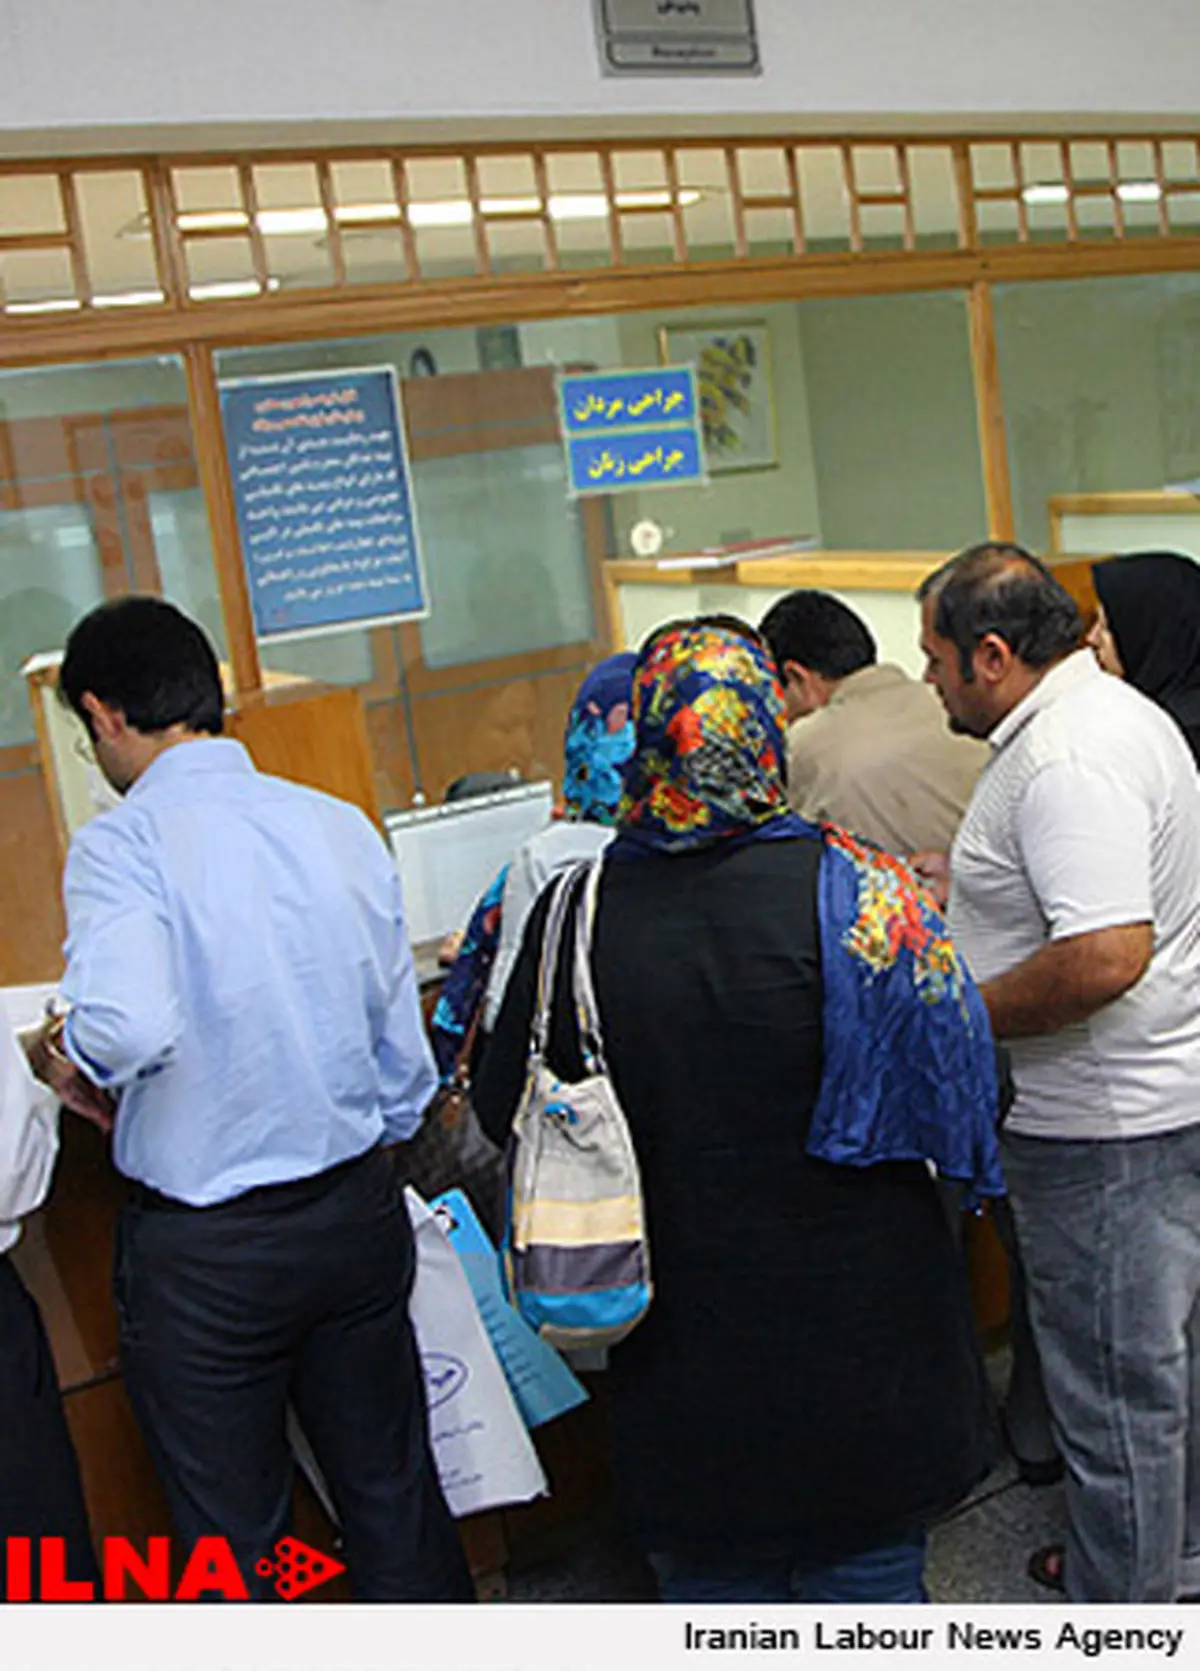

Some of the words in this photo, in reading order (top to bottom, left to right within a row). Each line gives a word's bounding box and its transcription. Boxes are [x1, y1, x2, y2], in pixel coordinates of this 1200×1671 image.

[573, 392, 624, 421] مردان
[628, 388, 684, 416] جراحی
[588, 450, 625, 479] زنان
[628, 446, 684, 475] جراحی
